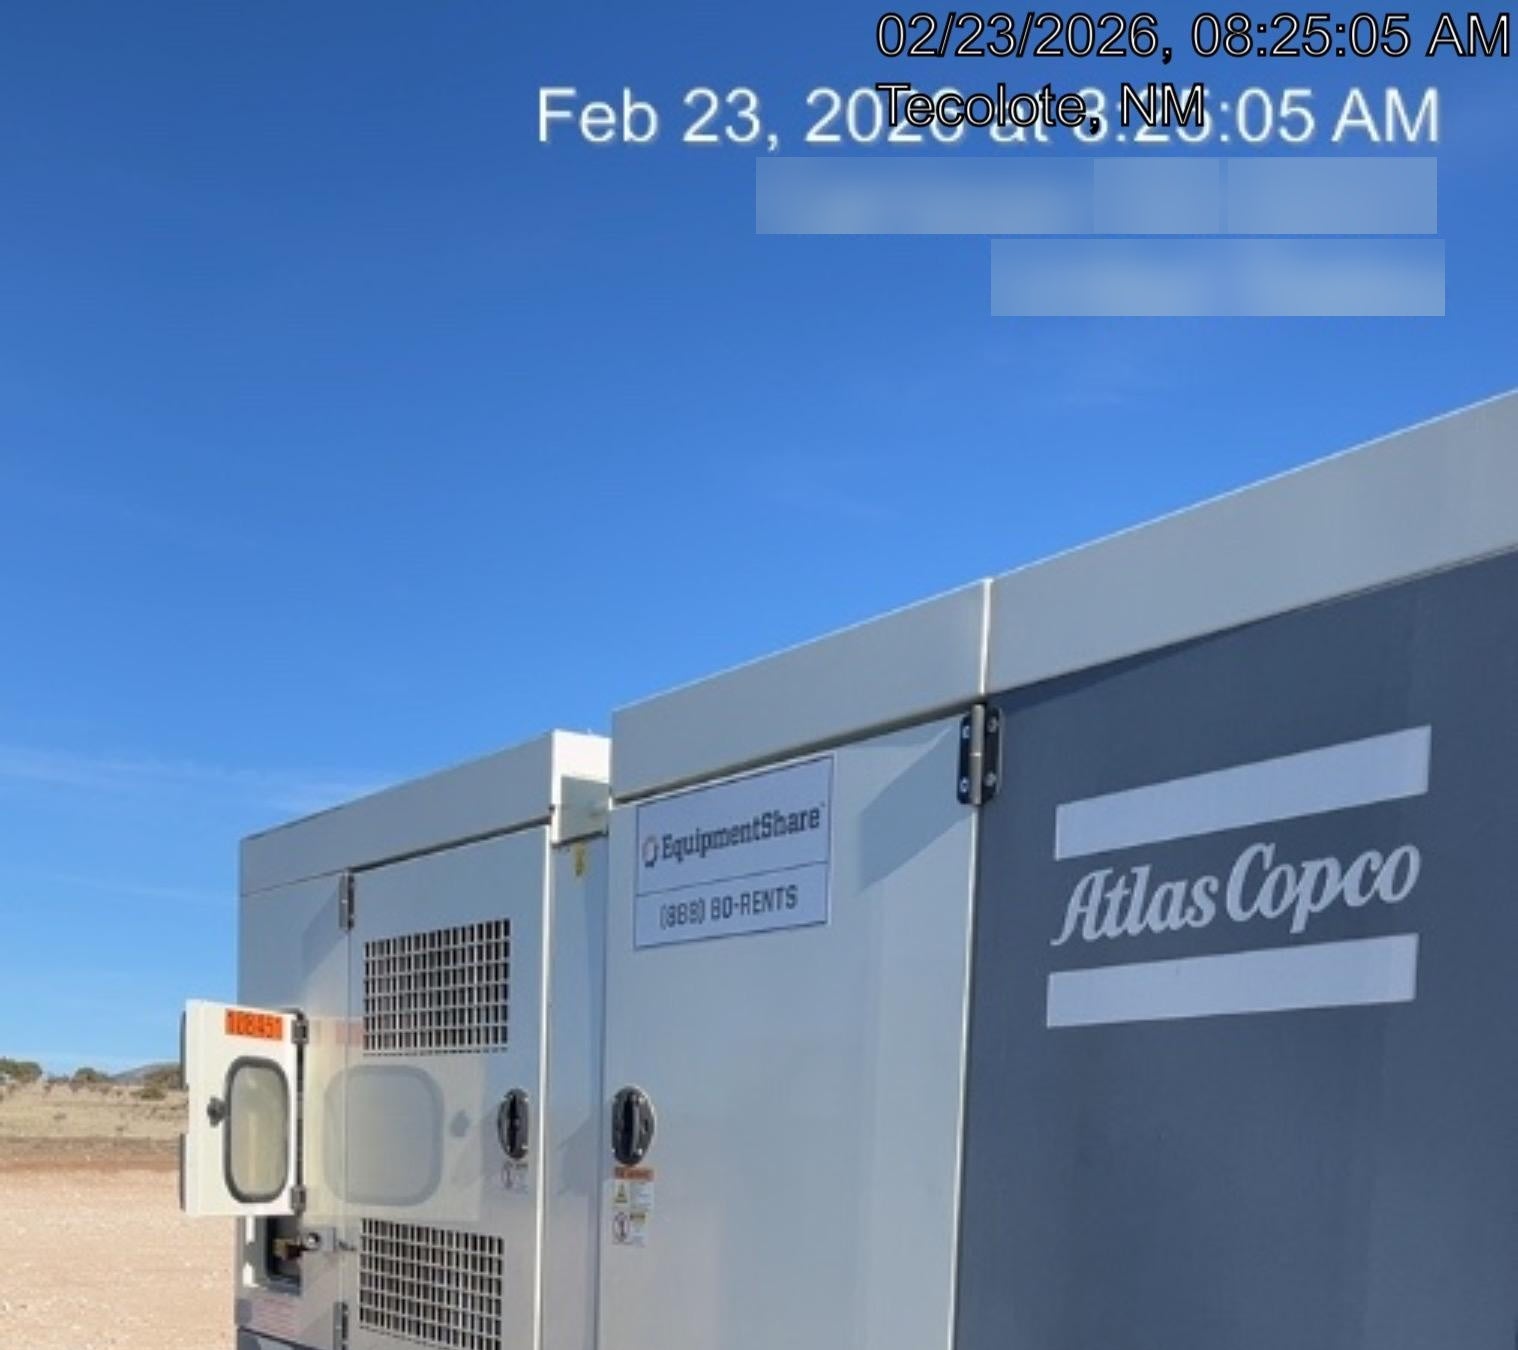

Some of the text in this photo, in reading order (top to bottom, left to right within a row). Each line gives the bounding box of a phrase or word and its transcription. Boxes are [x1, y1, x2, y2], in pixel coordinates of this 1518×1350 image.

[661, 807, 821, 863] EquipmentShare
[1050, 843, 1421, 946] Atlas Copco
